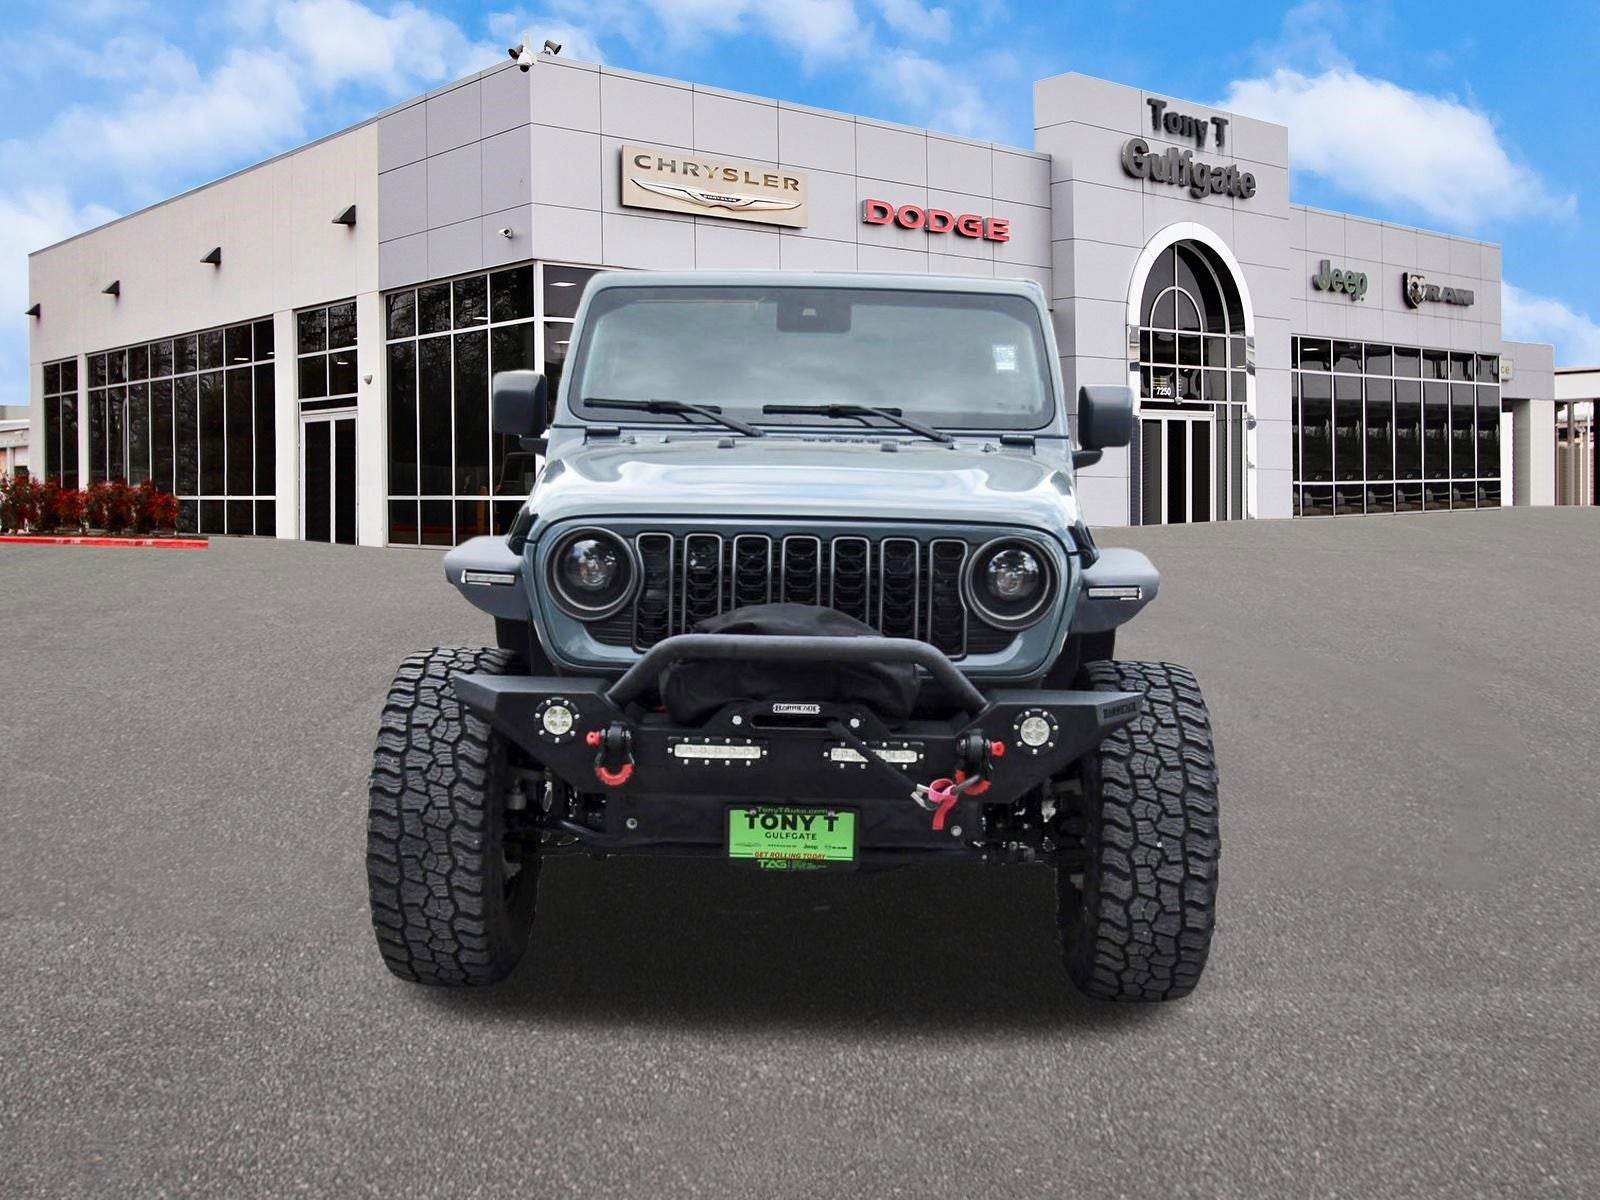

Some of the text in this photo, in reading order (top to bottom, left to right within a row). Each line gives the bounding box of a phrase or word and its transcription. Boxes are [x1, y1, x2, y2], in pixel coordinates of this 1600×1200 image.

[1146, 98, 1229, 147] Tony T
[633, 153, 800, 192] CHRYSLER
[1121, 138, 1257, 199] Gulfgate
[863, 198, 1011, 243] DODGE
[1312, 259, 1368, 302] Jeep
[1425, 283, 1475, 307] RAM
[1156, 387, 1172, 396] 7250
[744, 812, 840, 832] TONY T
[764, 831, 817, 841] GULFGATE
[758, 859, 787, 869] TAG
[769, 851, 802, 860] ROLLING
